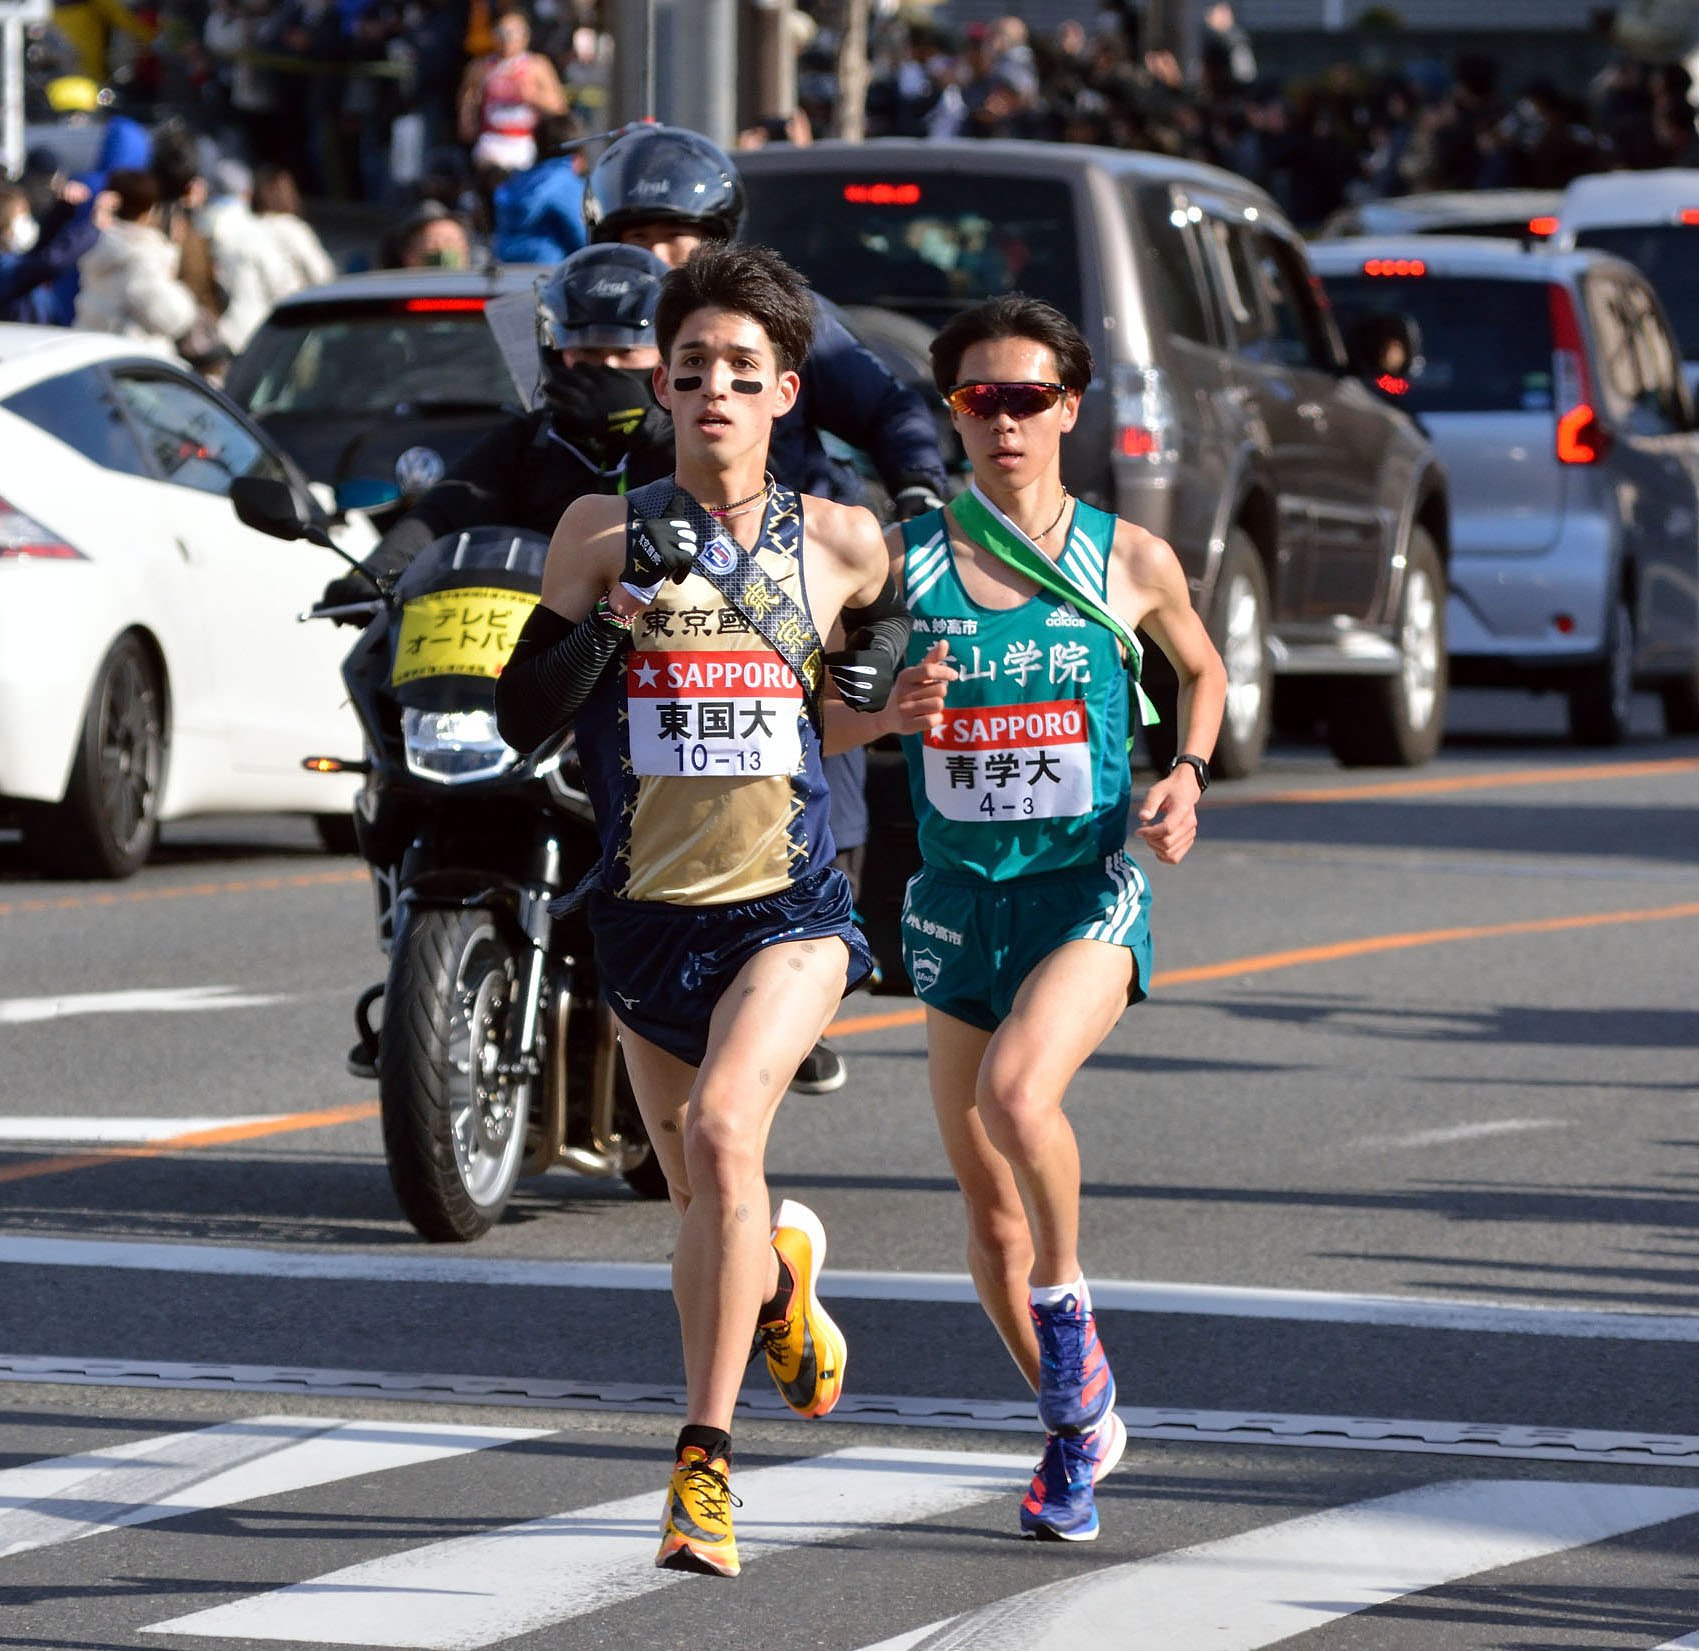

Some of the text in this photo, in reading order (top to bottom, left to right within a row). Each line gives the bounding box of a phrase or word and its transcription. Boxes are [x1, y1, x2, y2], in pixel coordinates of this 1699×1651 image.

[433, 607, 512, 629] テレビ
[641, 606, 761, 638] 東京國
[932, 618, 978, 636] 妙高市
[1045, 616, 1087, 628] adidas
[406, 629, 516, 655] オートバ
[667, 662, 797, 689] SAPPORO
[925, 639, 1092, 688] 山学院
[656, 700, 776, 739] 東国大
[953, 710, 1082, 743] SAPPORO
[945, 750, 1061, 790] 青学大
